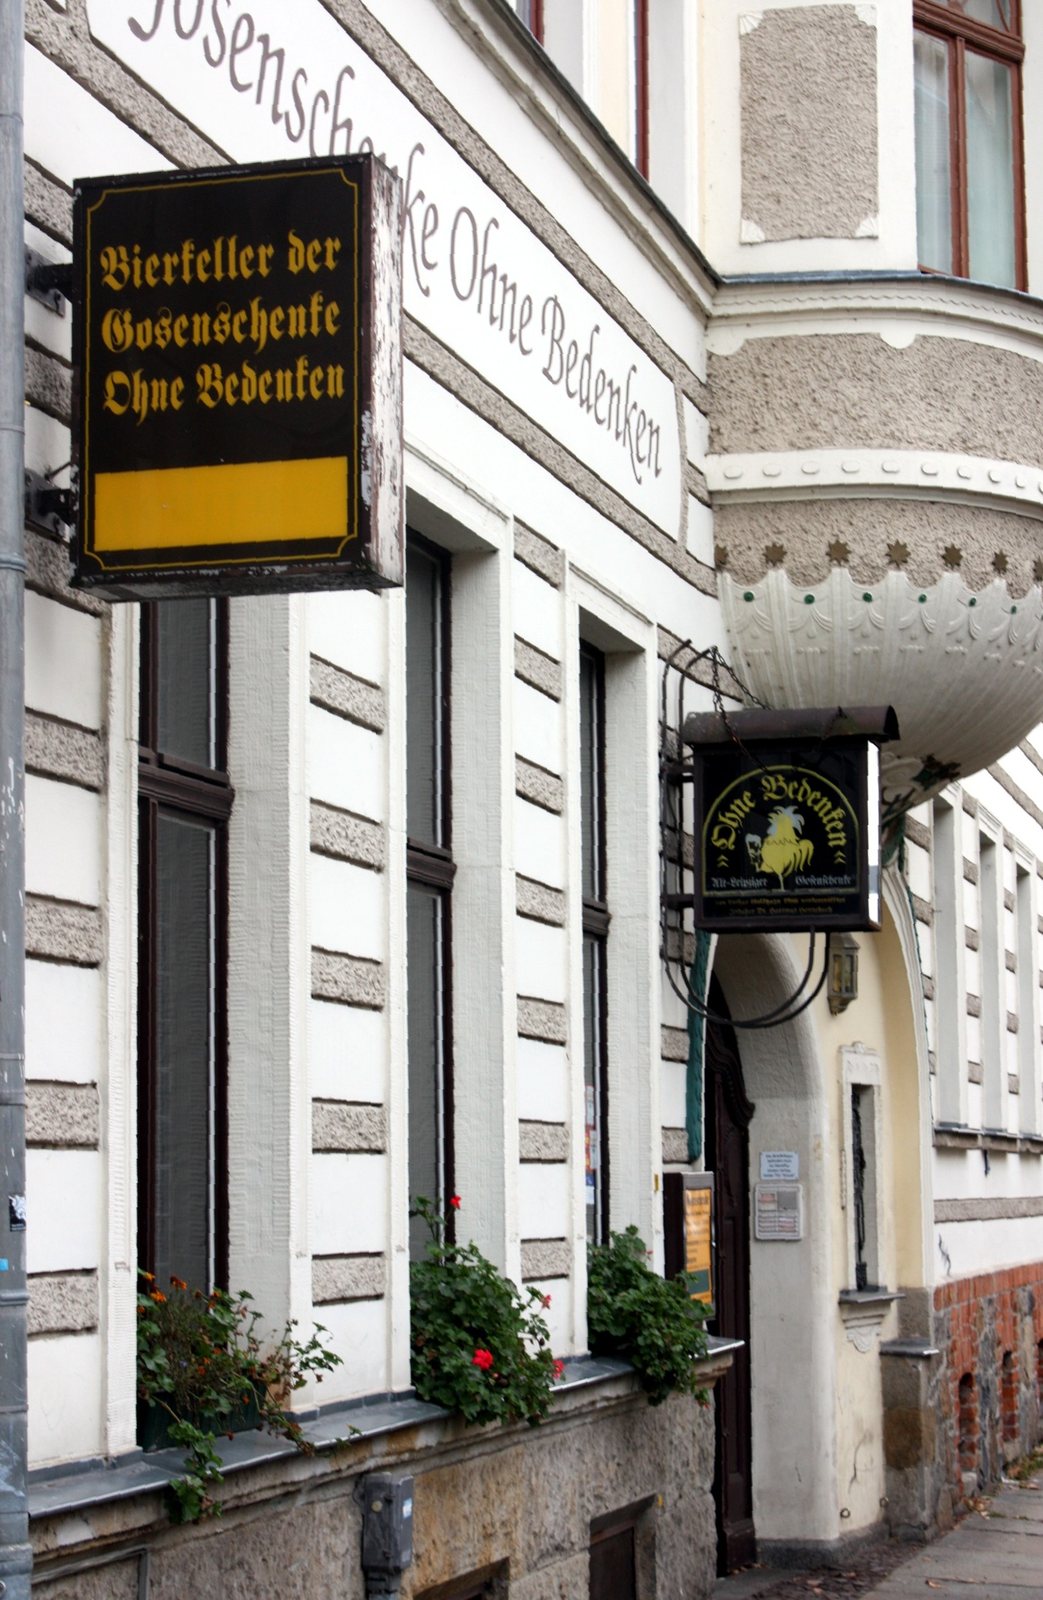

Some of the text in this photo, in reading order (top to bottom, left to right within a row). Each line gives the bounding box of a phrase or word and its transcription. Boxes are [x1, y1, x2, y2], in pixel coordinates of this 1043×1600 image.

[100, 229, 342, 291] Bierkeller der
[101, 290, 341, 354] Gosenschenke
[449, 206, 533, 356] Ohne
[541, 294, 662, 485] Bedenken
[103, 354, 345, 426] Ohne Bedenken
[711, 774, 847, 850] Ohne Bedenken
